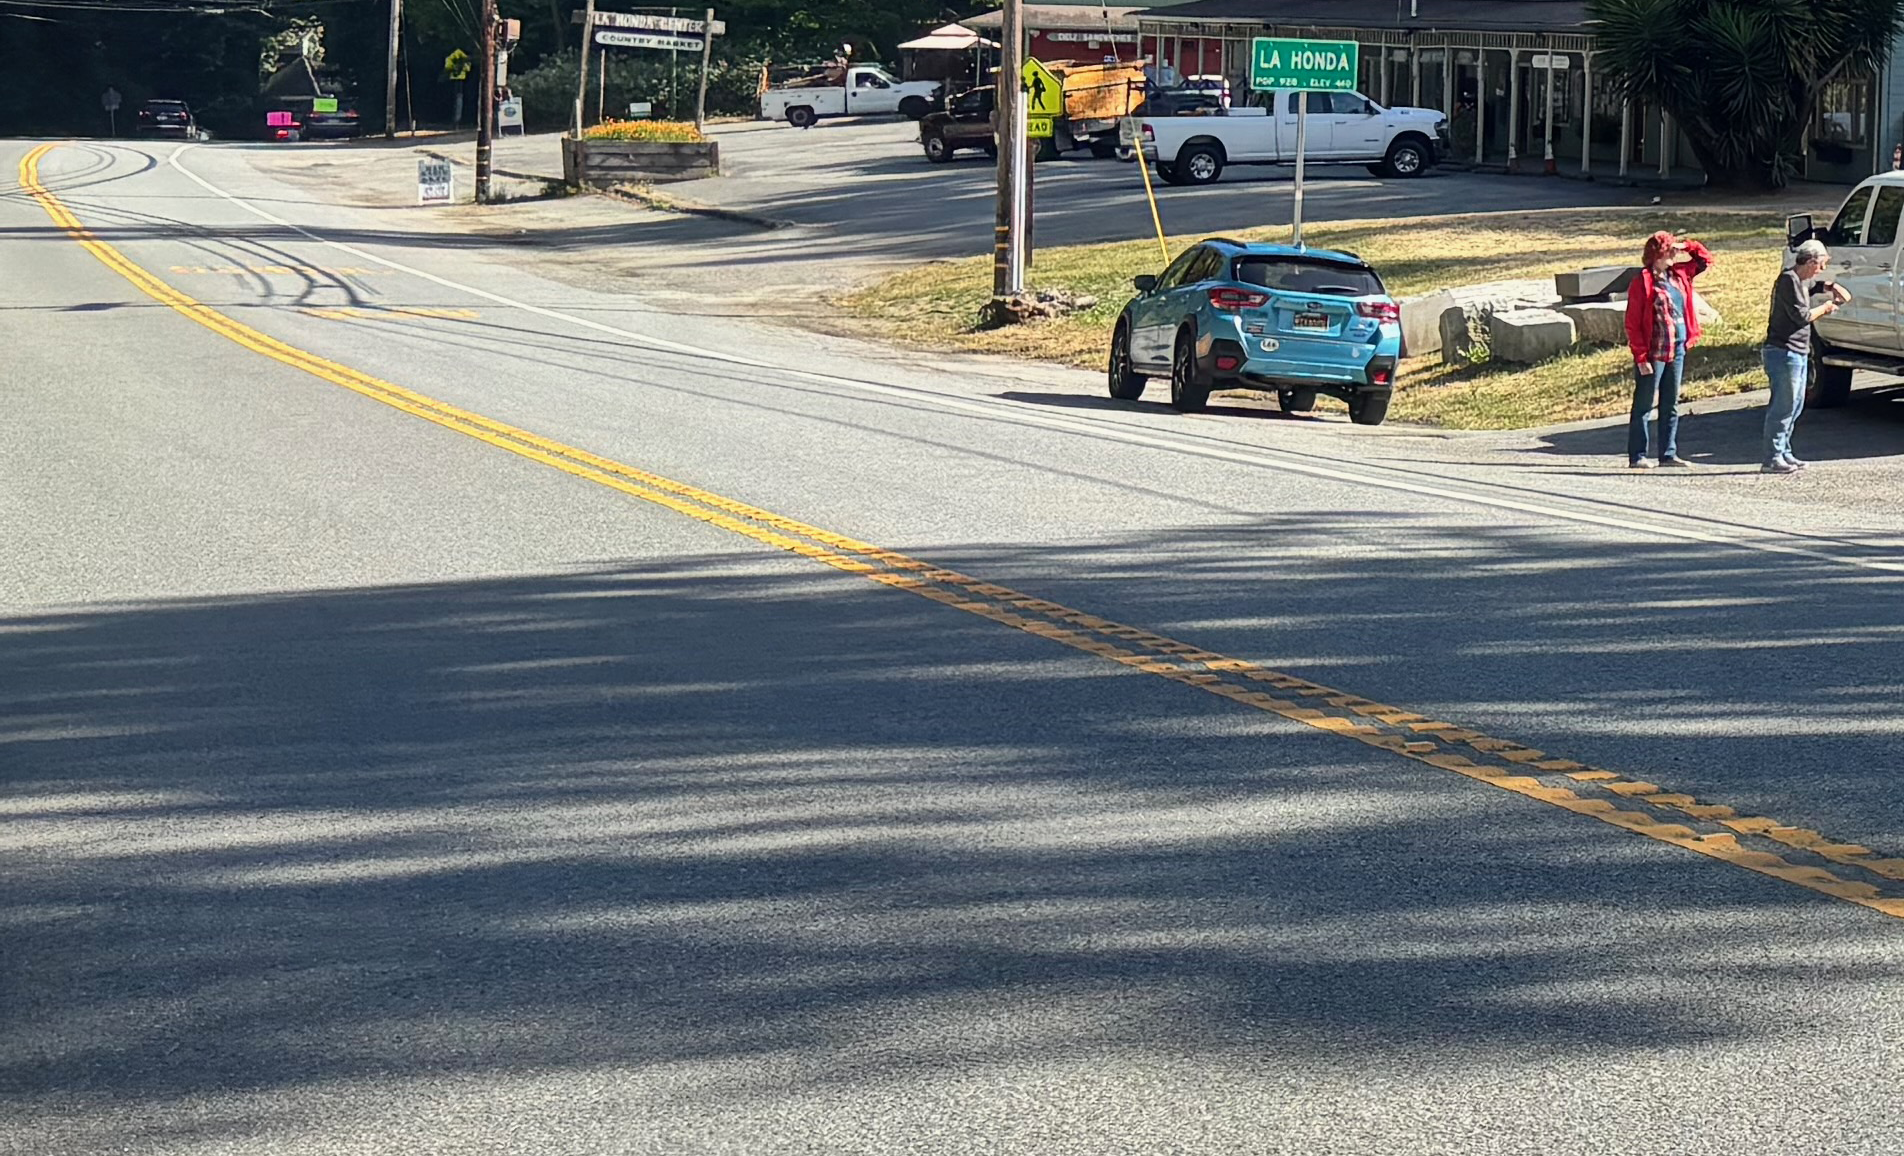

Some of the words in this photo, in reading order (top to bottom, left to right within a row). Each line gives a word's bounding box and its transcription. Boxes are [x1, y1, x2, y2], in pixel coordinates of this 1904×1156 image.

[1260, 49, 1281, 69] LA
[1290, 50, 1350, 71] HONDA
[1255, 76, 1275, 86] POP
